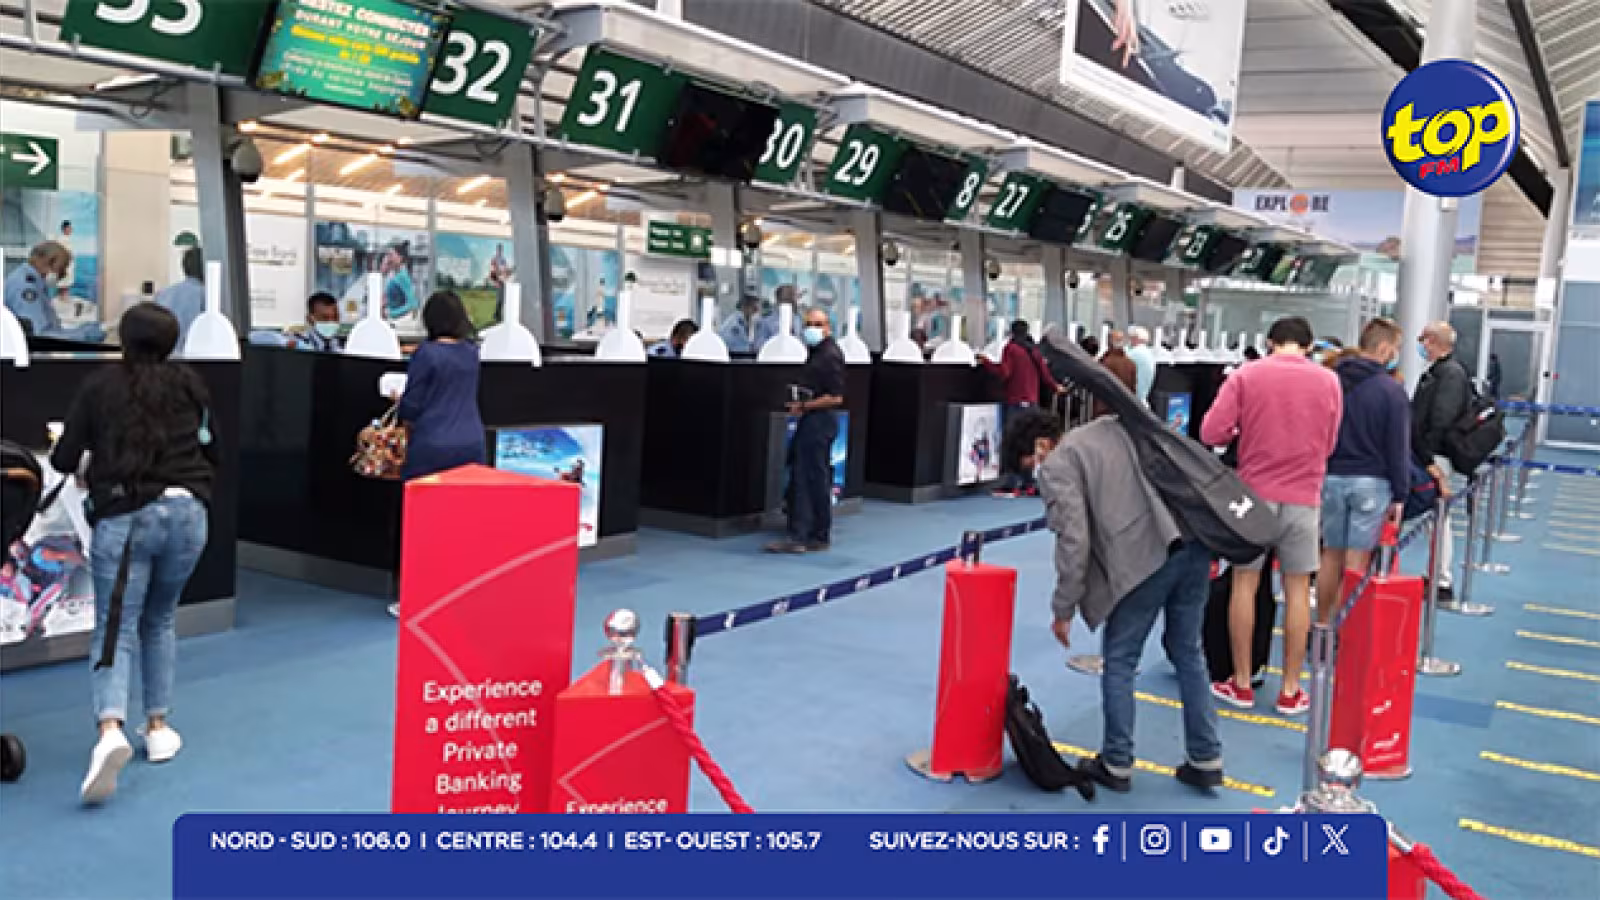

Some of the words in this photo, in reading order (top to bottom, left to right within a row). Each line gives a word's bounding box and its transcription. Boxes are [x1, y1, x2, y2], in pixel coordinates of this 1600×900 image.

[431, 31, 511, 103] 32
[577, 69, 642, 132] 31
[834, 139, 881, 187] 29
[956, 171, 980, 209] 8
[993, 181, 1031, 219] 27
[423, 677, 543, 706] Experience
[424, 716, 439, 734] a
[445, 707, 538, 732] different
[442, 740, 518, 763] Private
[436, 769, 522, 794] Banking
[566, 796, 669, 814] Experience
